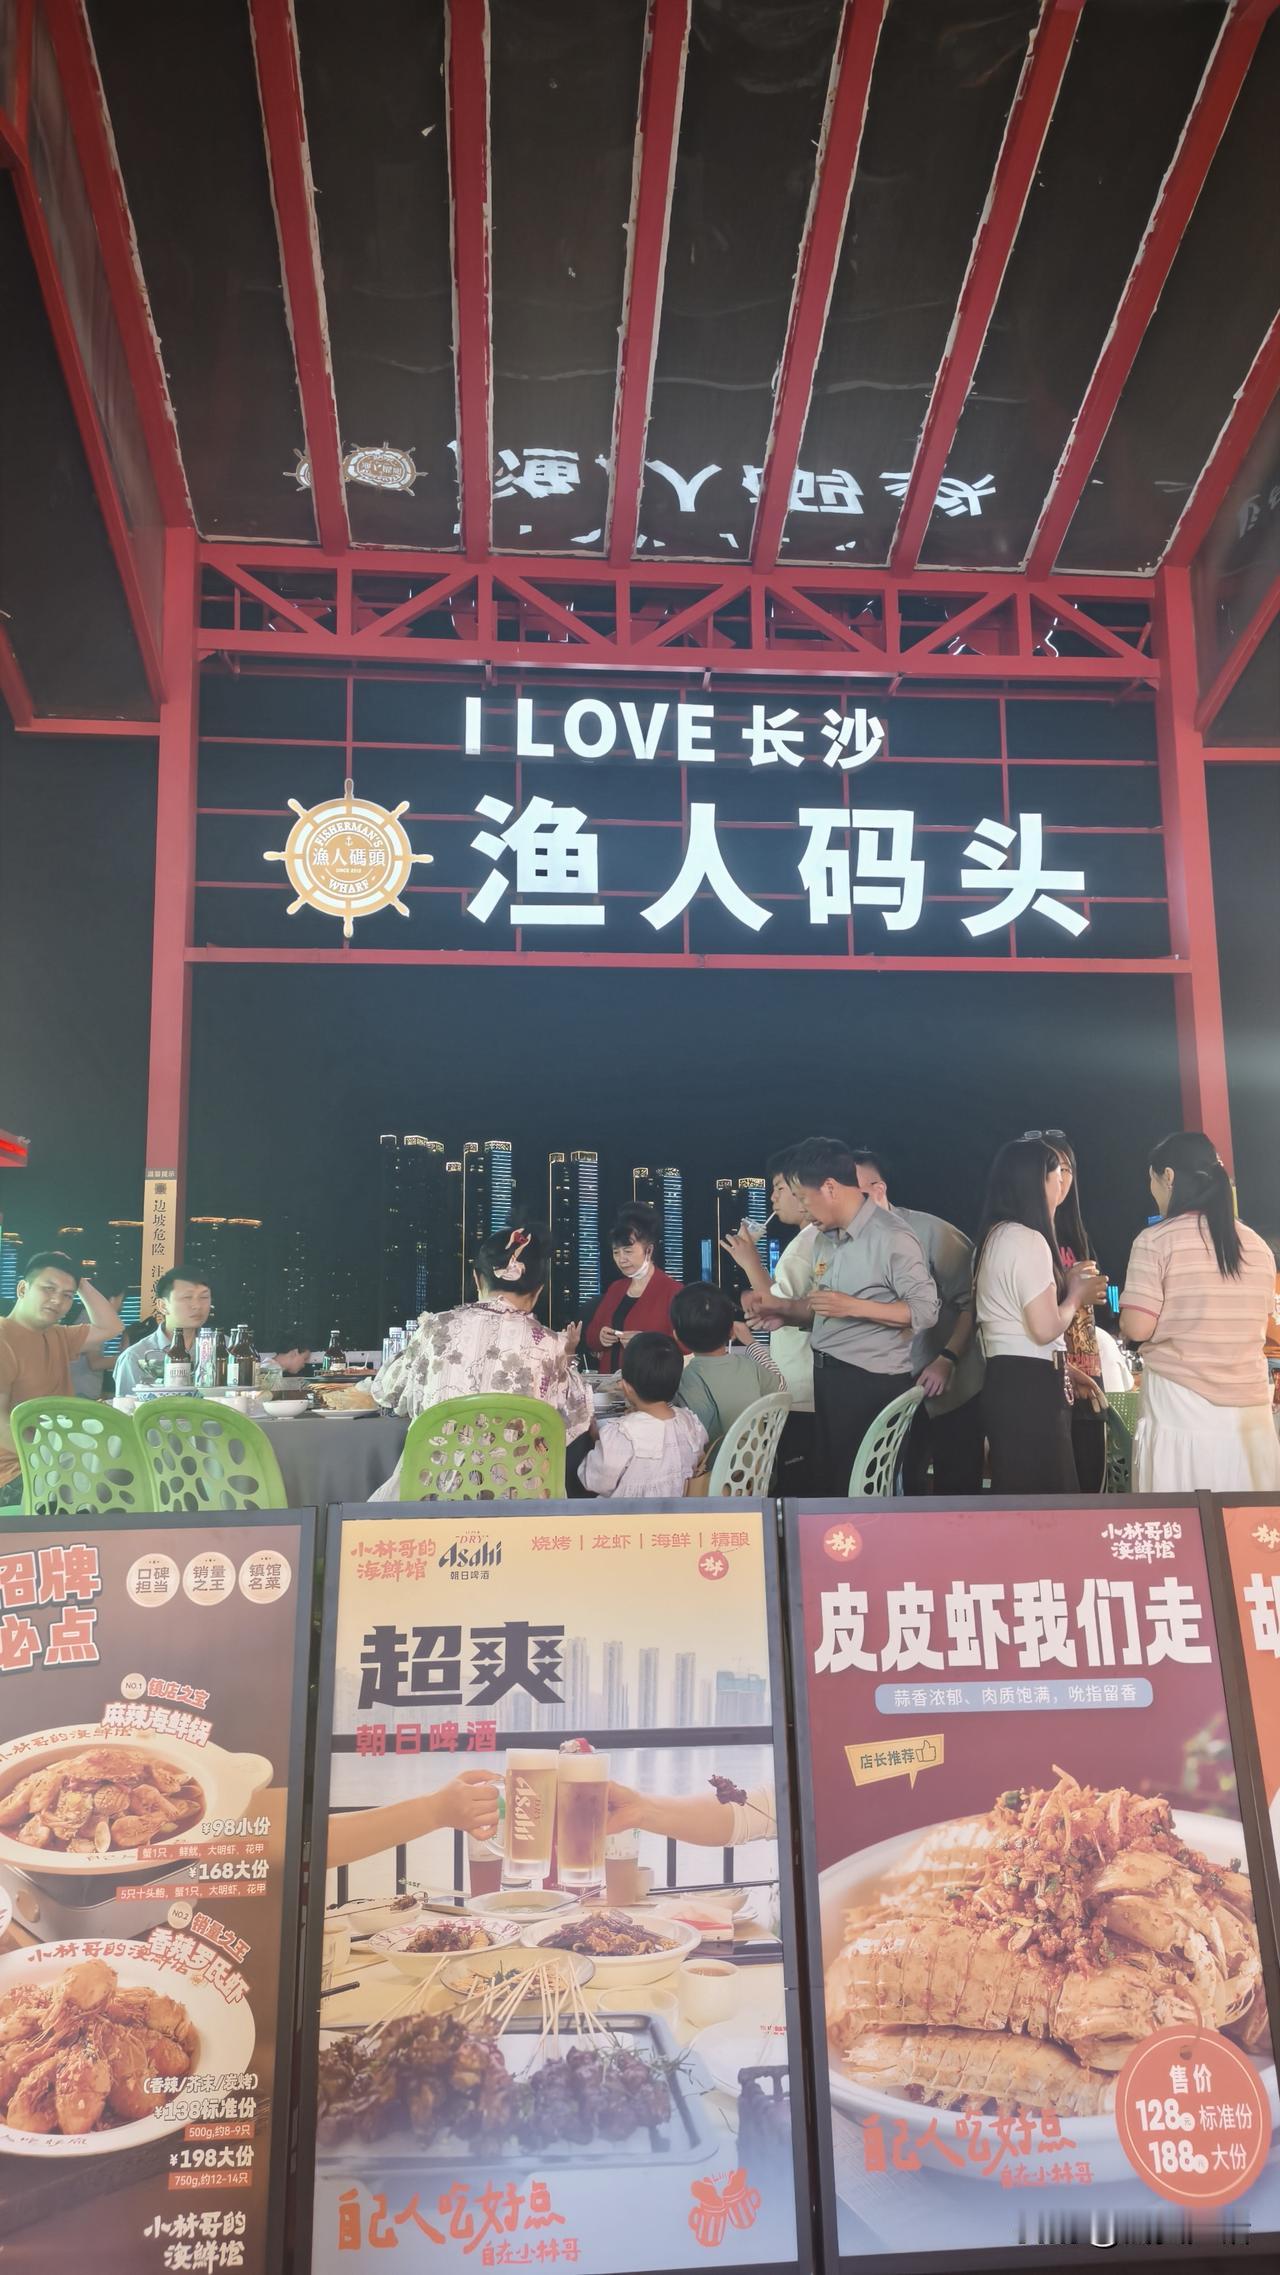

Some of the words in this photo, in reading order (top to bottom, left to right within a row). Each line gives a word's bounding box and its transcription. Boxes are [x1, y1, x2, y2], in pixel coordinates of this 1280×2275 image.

[464, 696, 481, 756] I
[516, 699, 716, 763] LOVE
[741, 705, 886, 770] 长沙
[313, 821, 384, 848] FISHERMAN'S
[466, 795, 1090, 939] 渔人码头
[329, 879, 370, 894] WHARF
[438, 1540, 502, 1568] Asahi
[531, 1535, 572, 1551] 烧烤
[592, 1534, 632, 1549] 龙虾
[651, 1532, 692, 1548] 海鲜
[711, 1531, 750, 1547] 精酿
[137, 1567, 170, 1580] 口碑
[193, 1565, 226, 1579] 销量
[248, 1577, 281, 1591] 名菜
[249, 1563, 282, 1577] 镇馆
[450, 1570, 490, 1580] 朝日啤酒
[135, 1580, 169, 1594] 担当
[193, 1579, 225, 1592] 之王
[0, 1605, 100, 1671] 必点
[814, 1576, 1213, 1674] 皮皮虾我们走
[358, 1621, 566, 1710] 超爽
[125, 1682, 142, 1690] NO.1
[147, 1678, 211, 1710] 镇店之宝
[356, 1720, 497, 1757] 朝日啤酒
[860, 1748, 915, 1769] 店长推荐
[172, 1909, 189, 1921] NO.2
[190, 1912, 251, 1963] 销量之王
[1169, 2063, 1212, 2094] 售价
[1199, 2103, 1253, 2131] 标准份
[862, 2104, 1077, 2177] 自己人吃好点
[1211, 2143, 1247, 2171] 大份
[337, 2180, 567, 2255] 自己人吃好点
